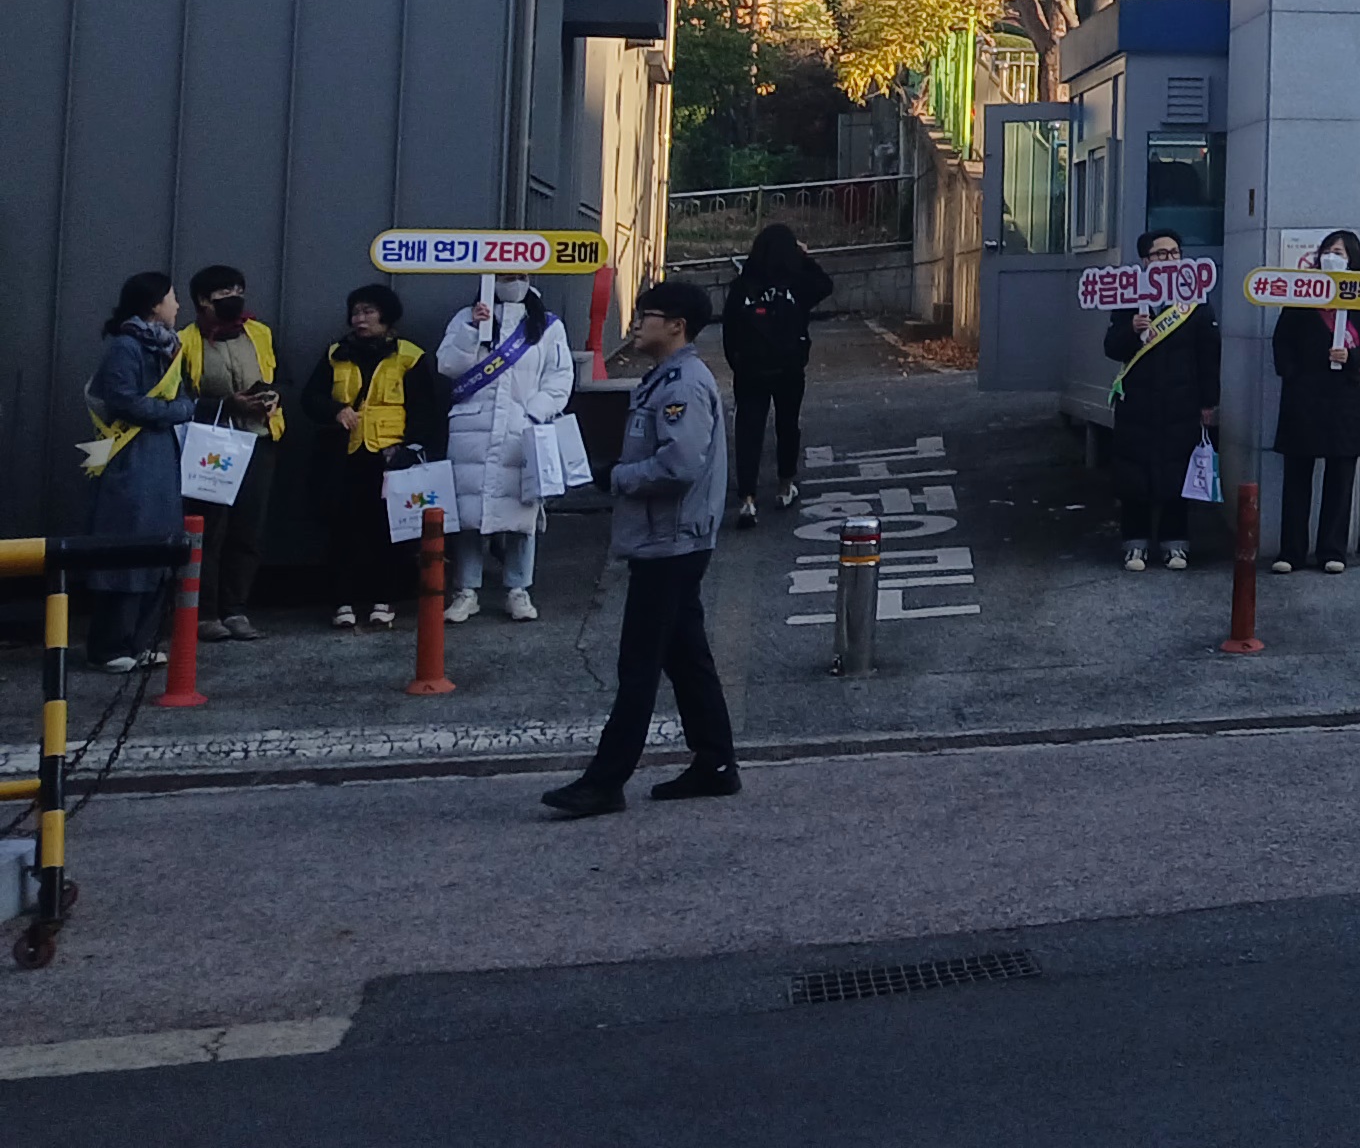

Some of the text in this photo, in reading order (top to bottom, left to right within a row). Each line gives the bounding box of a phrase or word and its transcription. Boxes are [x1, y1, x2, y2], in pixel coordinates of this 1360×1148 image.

[381, 239, 600, 264] 담배 연기 ZERO 김해
[1253, 277, 1288, 298] #술
[1293, 279, 1331, 299] 없이
